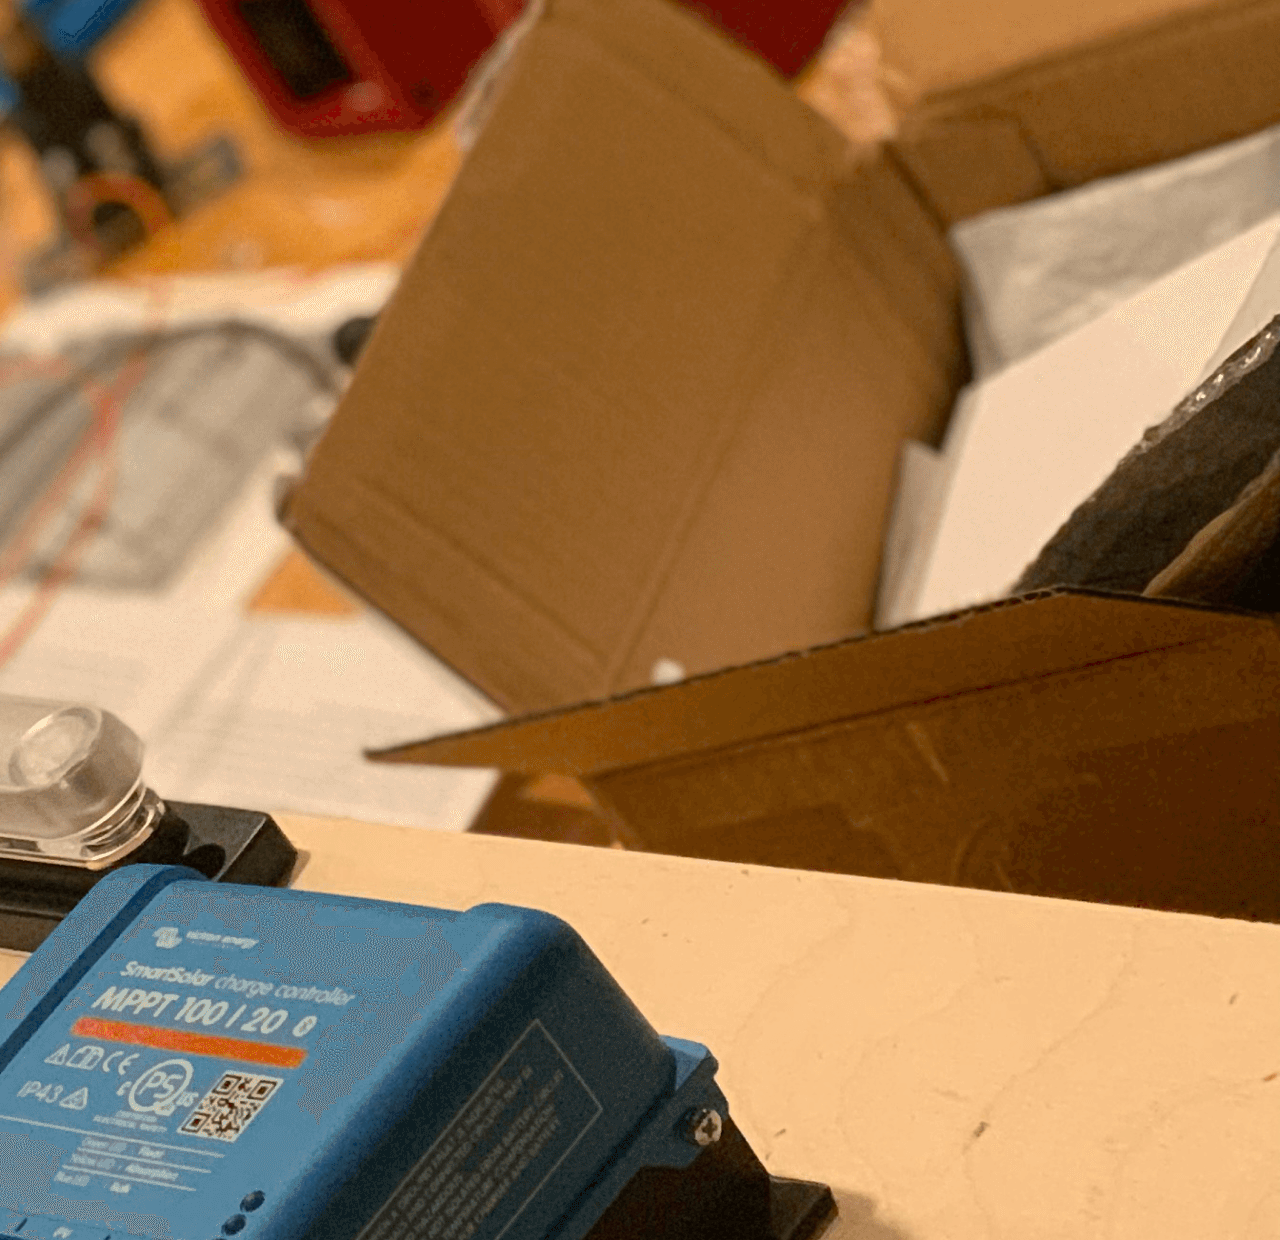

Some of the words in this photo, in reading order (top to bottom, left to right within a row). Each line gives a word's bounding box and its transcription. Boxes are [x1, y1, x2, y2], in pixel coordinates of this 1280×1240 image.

[120, 960, 216, 987] SmartSolar
[214, 974, 275, 998] charge
[274, 985, 356, 1005] controller
[91, 984, 181, 1018] MPPT
[17, 1080, 64, 1104] IP43
